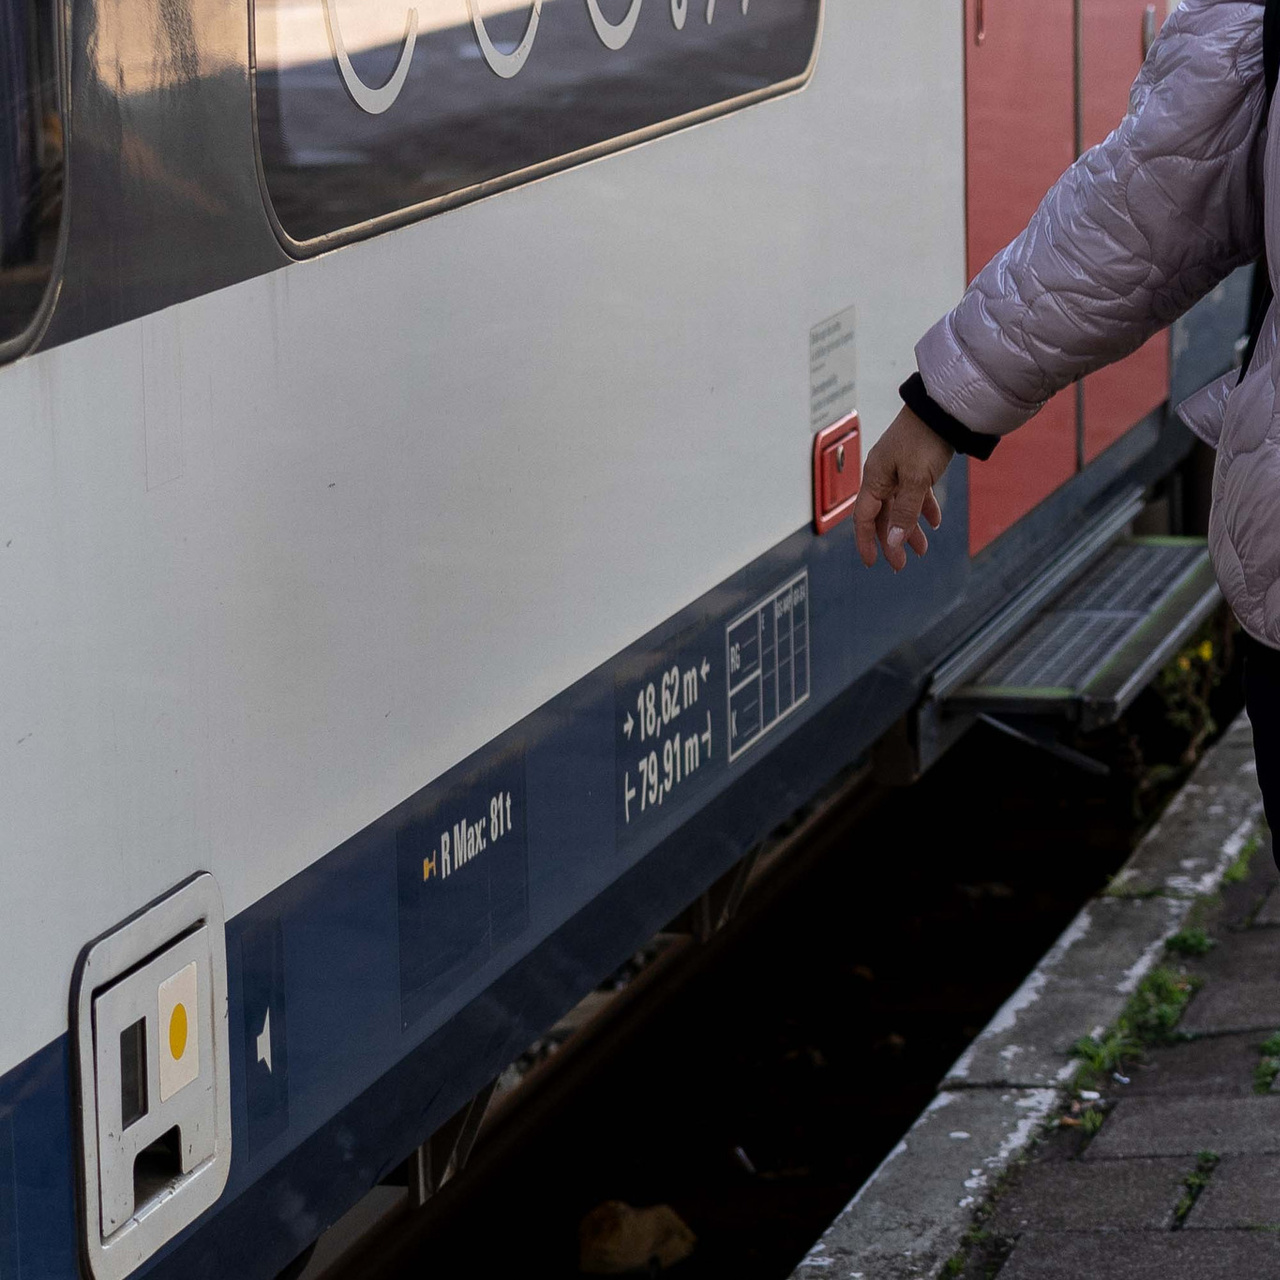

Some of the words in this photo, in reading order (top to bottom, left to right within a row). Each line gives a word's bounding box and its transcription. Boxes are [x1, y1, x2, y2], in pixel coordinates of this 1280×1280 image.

[637, 665, 681, 743] 18,62
[683, 666, 698, 710] m
[638, 732, 681, 812] 79,91
[684, 733, 700, 777] m
[440, 830, 451, 880] R
[453, 816, 487, 871] Max:
[490, 791, 504, 842] 81
